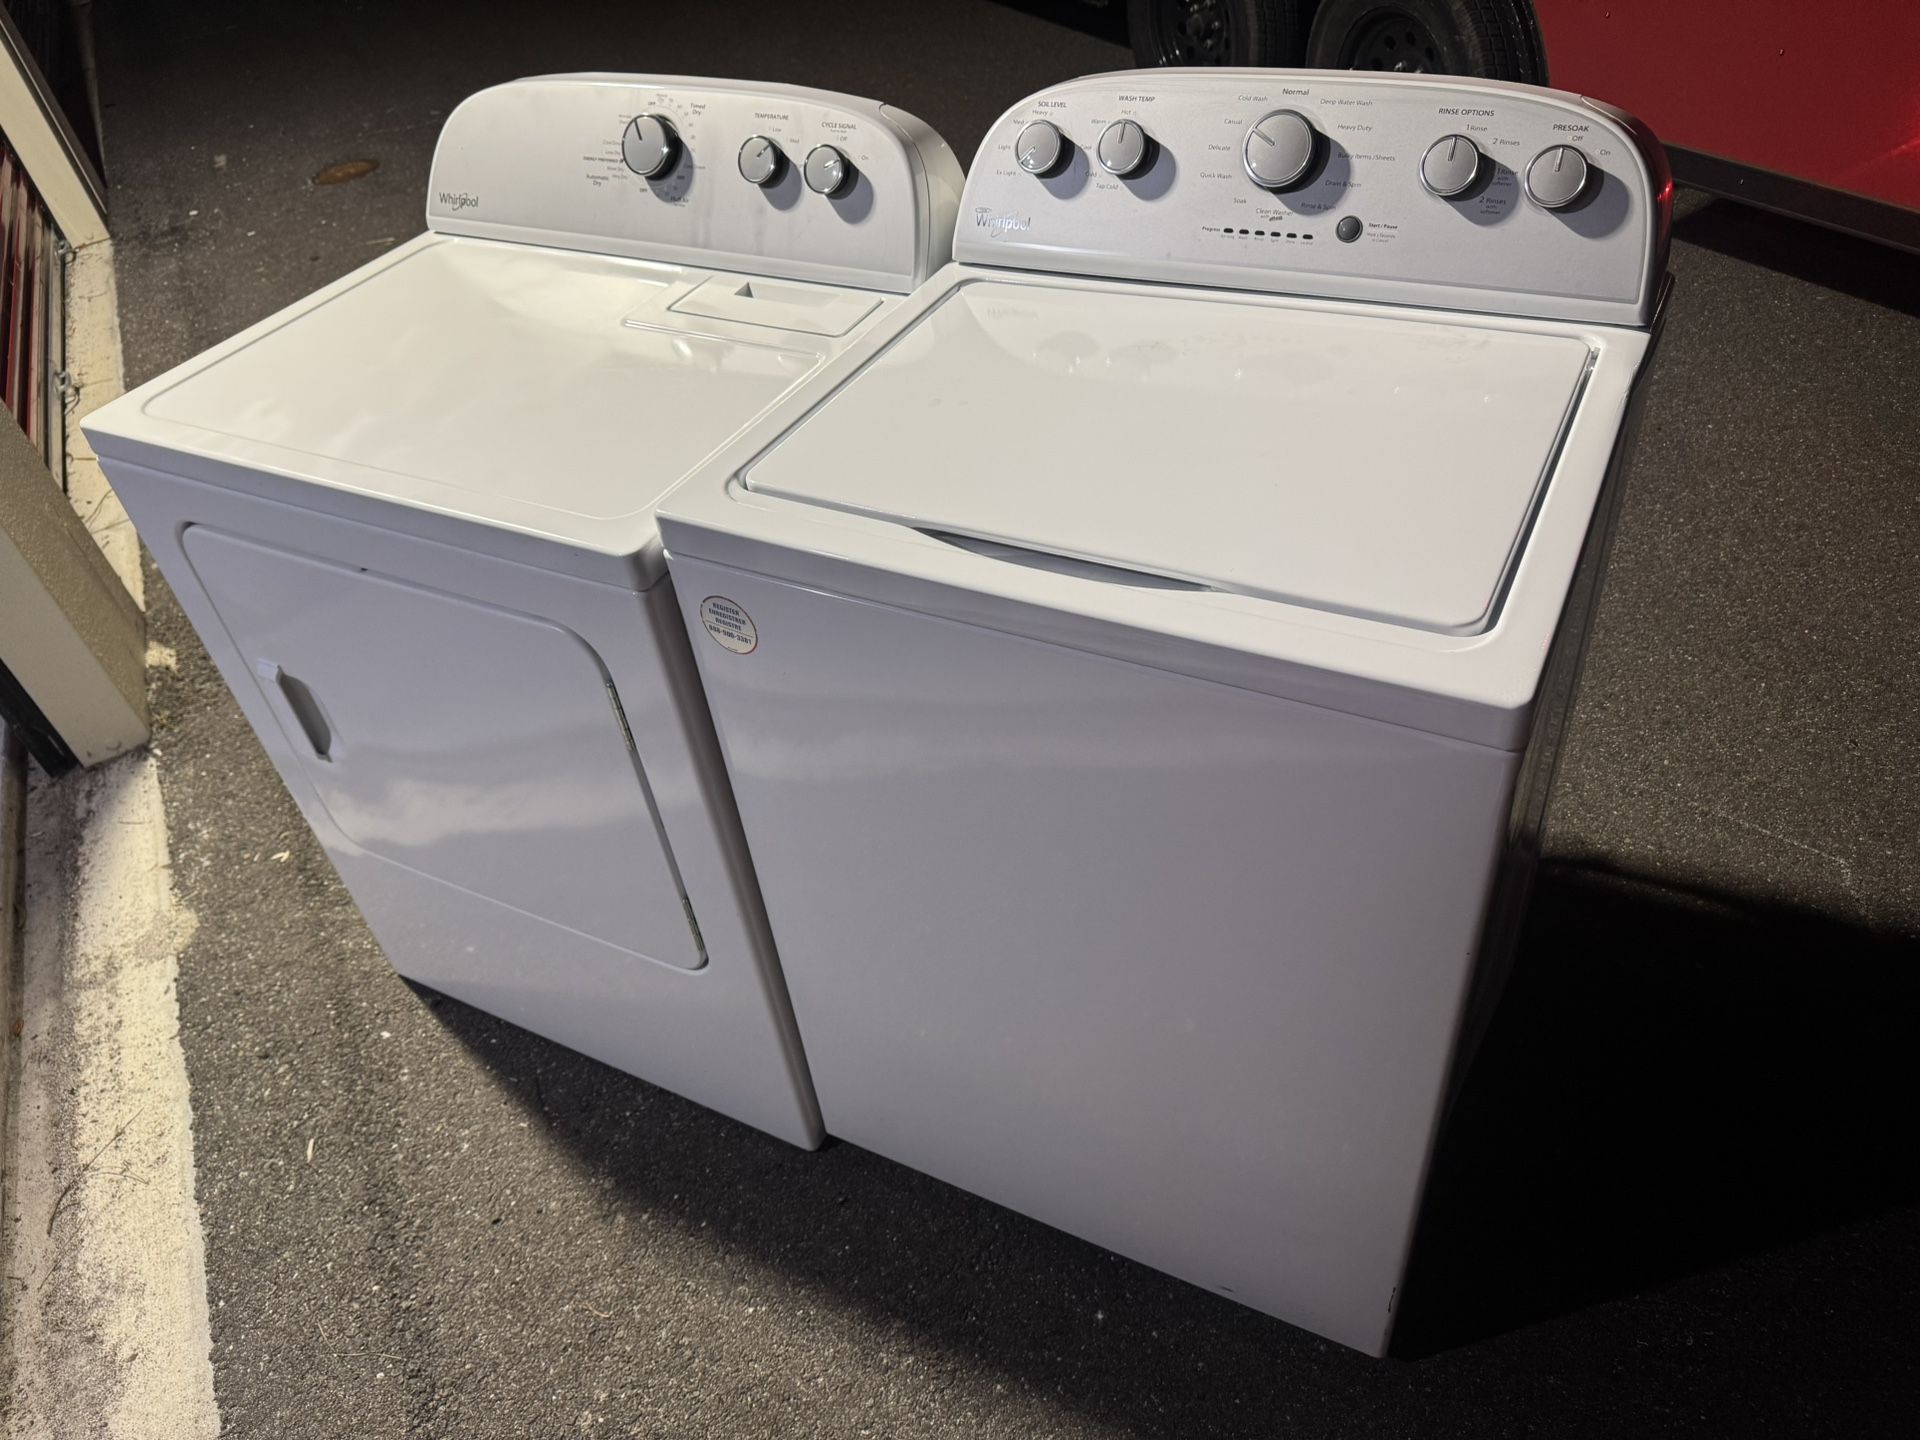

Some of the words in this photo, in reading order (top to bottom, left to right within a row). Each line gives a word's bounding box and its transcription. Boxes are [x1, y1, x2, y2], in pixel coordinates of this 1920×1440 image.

[1282, 88, 1309, 96] Normal
[690, 102, 706, 110] Timed
[754, 113, 789, 121] TEMPERATURE
[1461, 109, 1495, 117] OPTIONS
[1553, 124, 1590, 132] PRESOAK
[439, 192, 479, 211] Whirlpool
[976, 210, 1031, 237] Whirlpool
[712, 602, 740, 616] REGISTER
